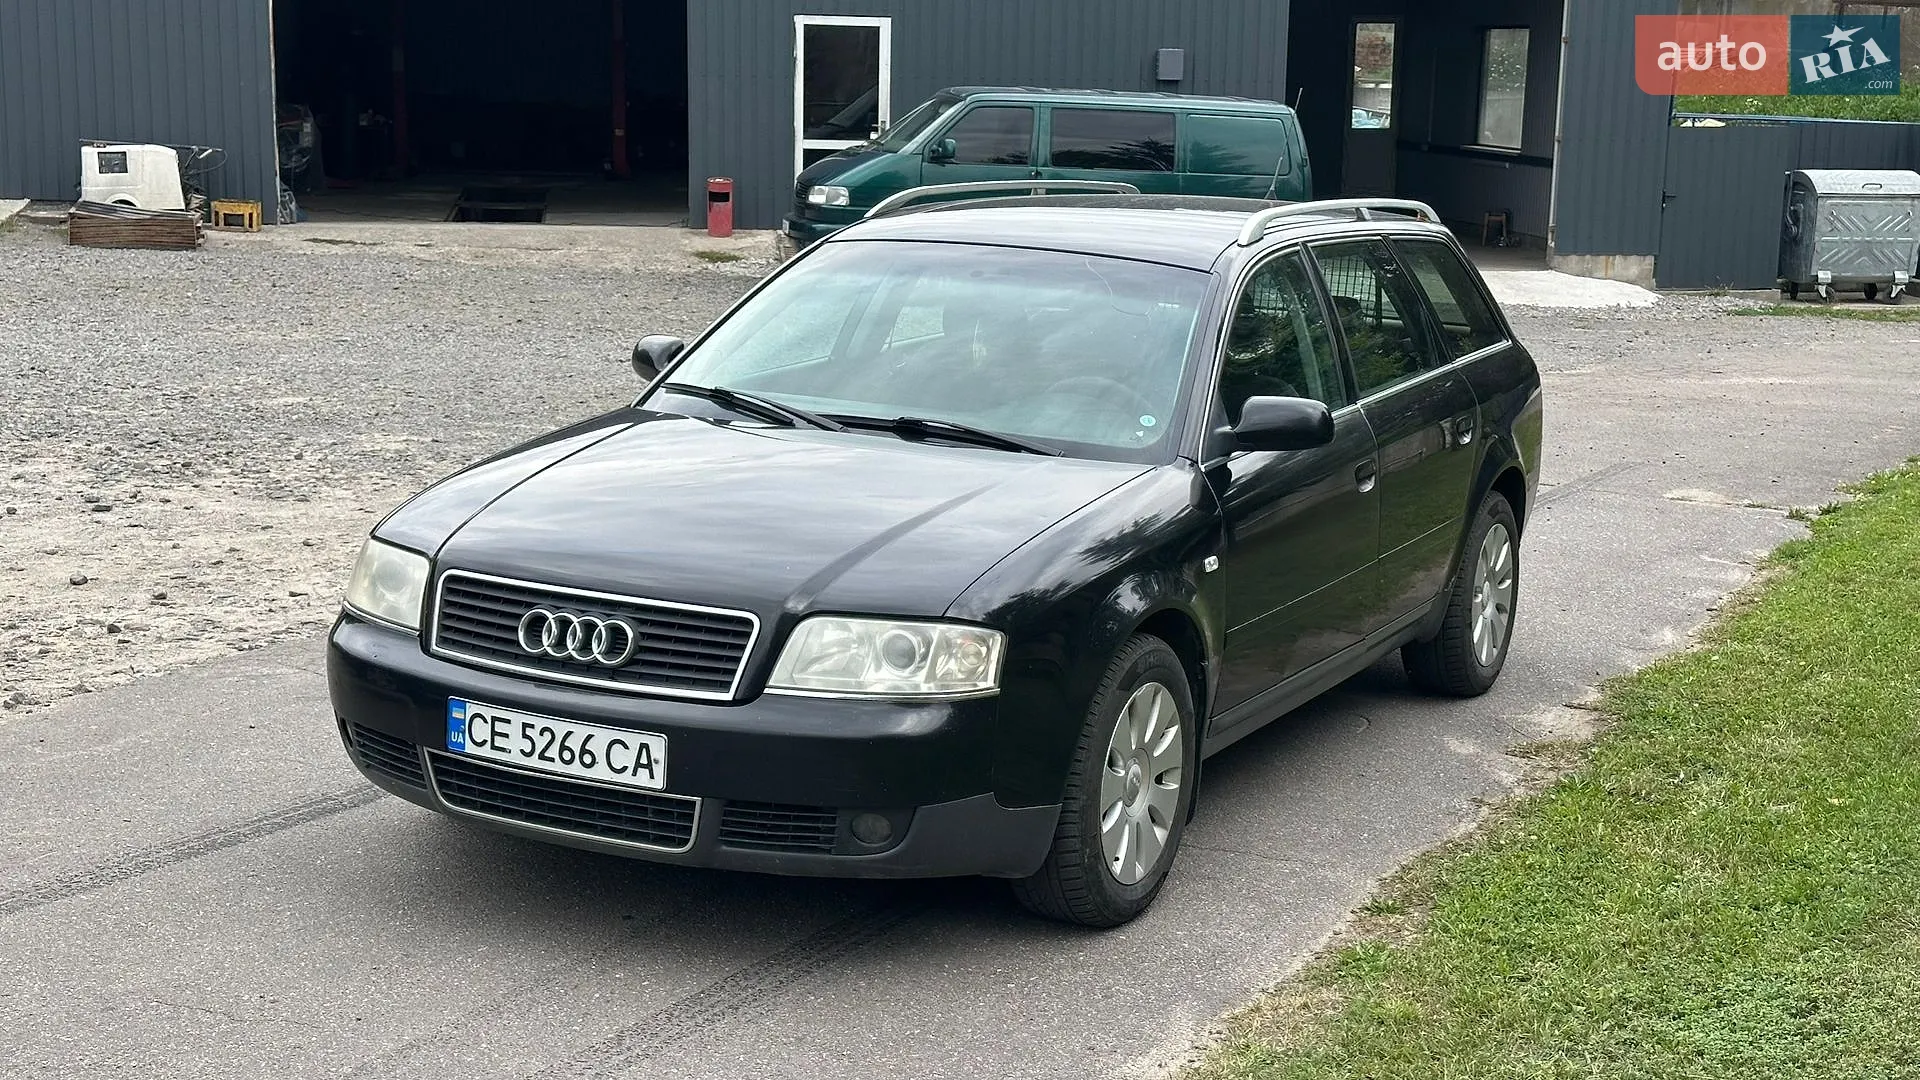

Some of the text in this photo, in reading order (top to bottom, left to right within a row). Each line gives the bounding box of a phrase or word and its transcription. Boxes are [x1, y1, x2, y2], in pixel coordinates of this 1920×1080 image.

[451, 730, 464, 744] UA
[467, 712, 655, 779] CE 5266 CA
